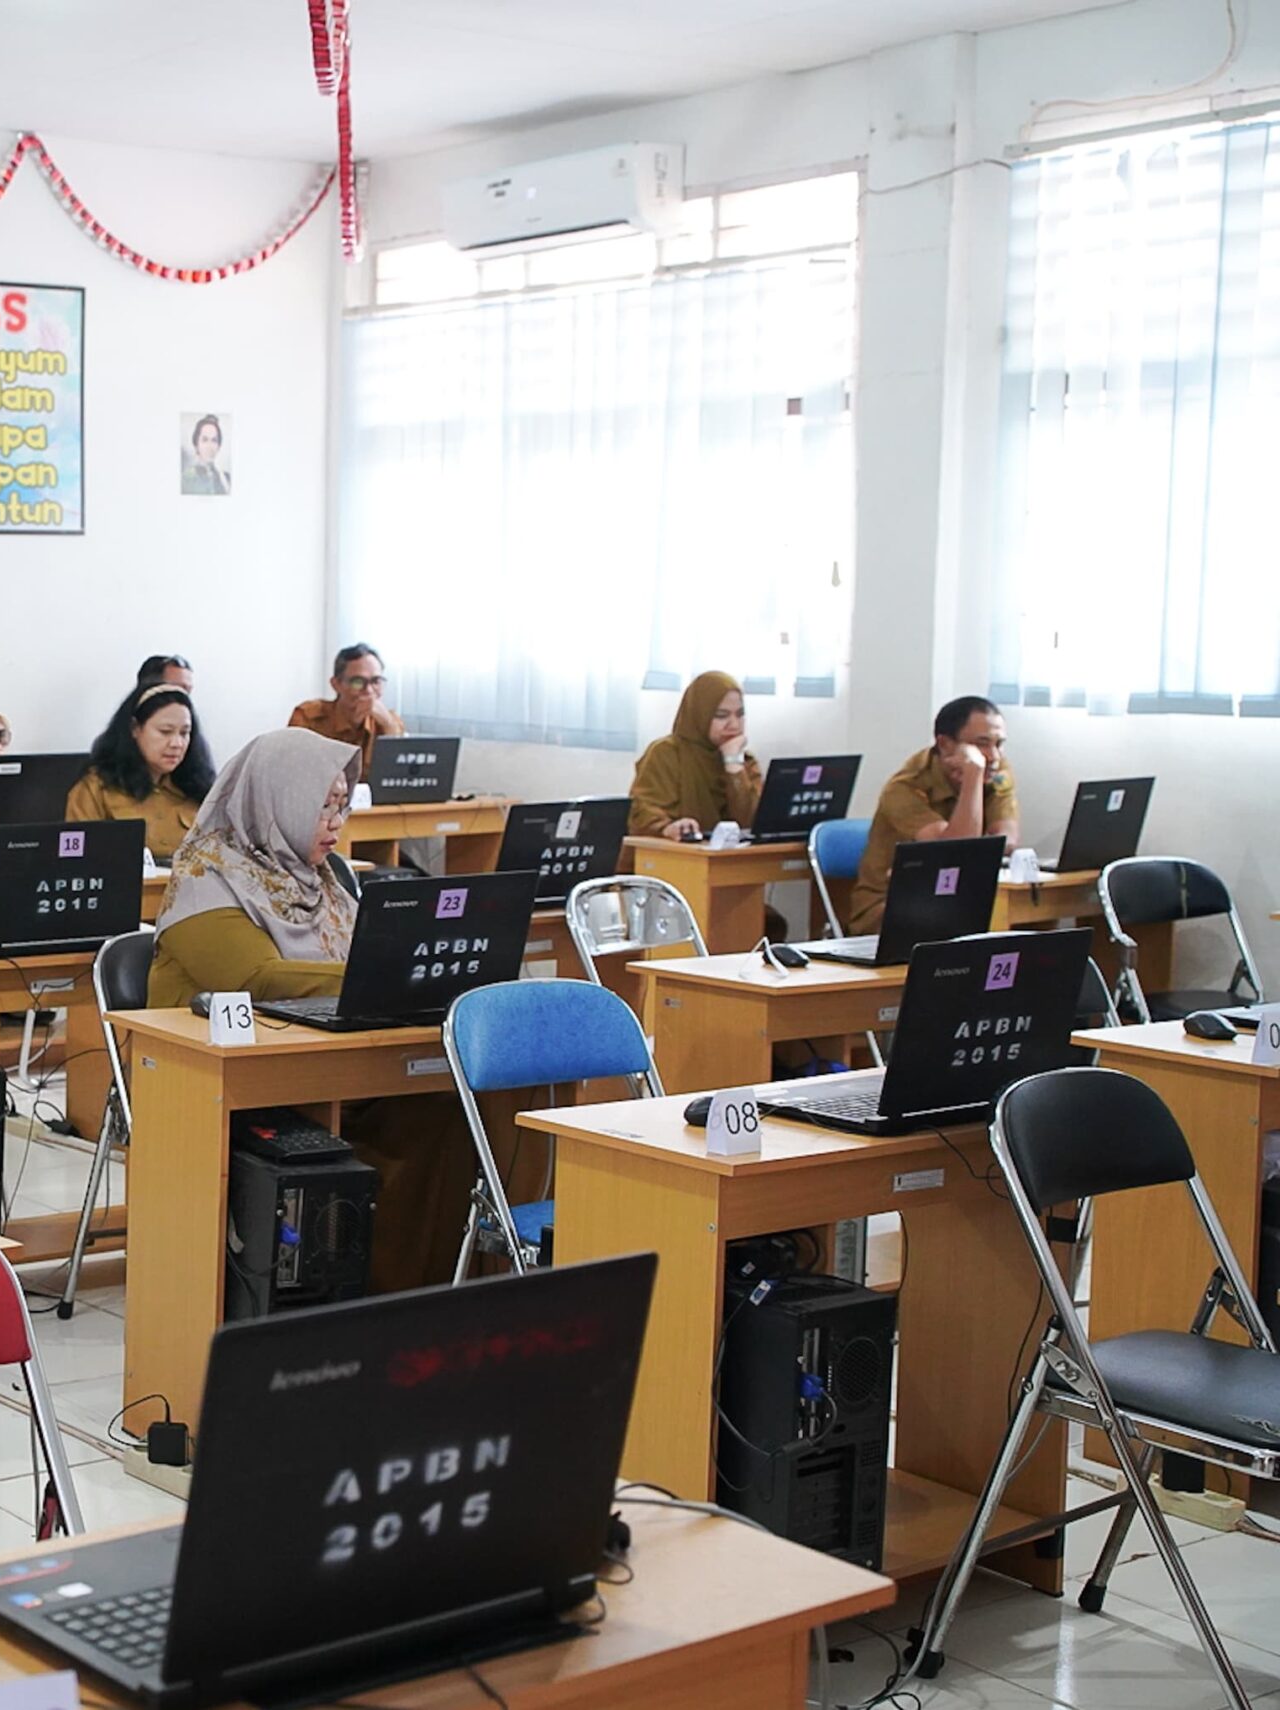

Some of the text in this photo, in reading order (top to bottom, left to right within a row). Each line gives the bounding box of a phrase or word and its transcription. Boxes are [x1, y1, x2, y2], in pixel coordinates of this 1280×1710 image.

[64, 838, 80, 851] 18
[541, 845, 595, 859] APBN
[539, 861, 588, 876] 2015
[36, 878, 103, 893] APBN
[944, 875, 951, 888] 1
[37, 897, 98, 914] 2015
[442, 896, 461, 911] 23
[413, 938, 489, 956] APBN
[410, 960, 480, 980] 2015
[992, 962, 1012, 981] 24
[221, 1004, 252, 1029] 13
[954, 1016, 1032, 1039] APBN
[951, 1043, 1021, 1066] 2015
[725, 1101, 758, 1135] 08
[323, 1434, 512, 1507] APBN
[322, 1491, 492, 1563] 2015
